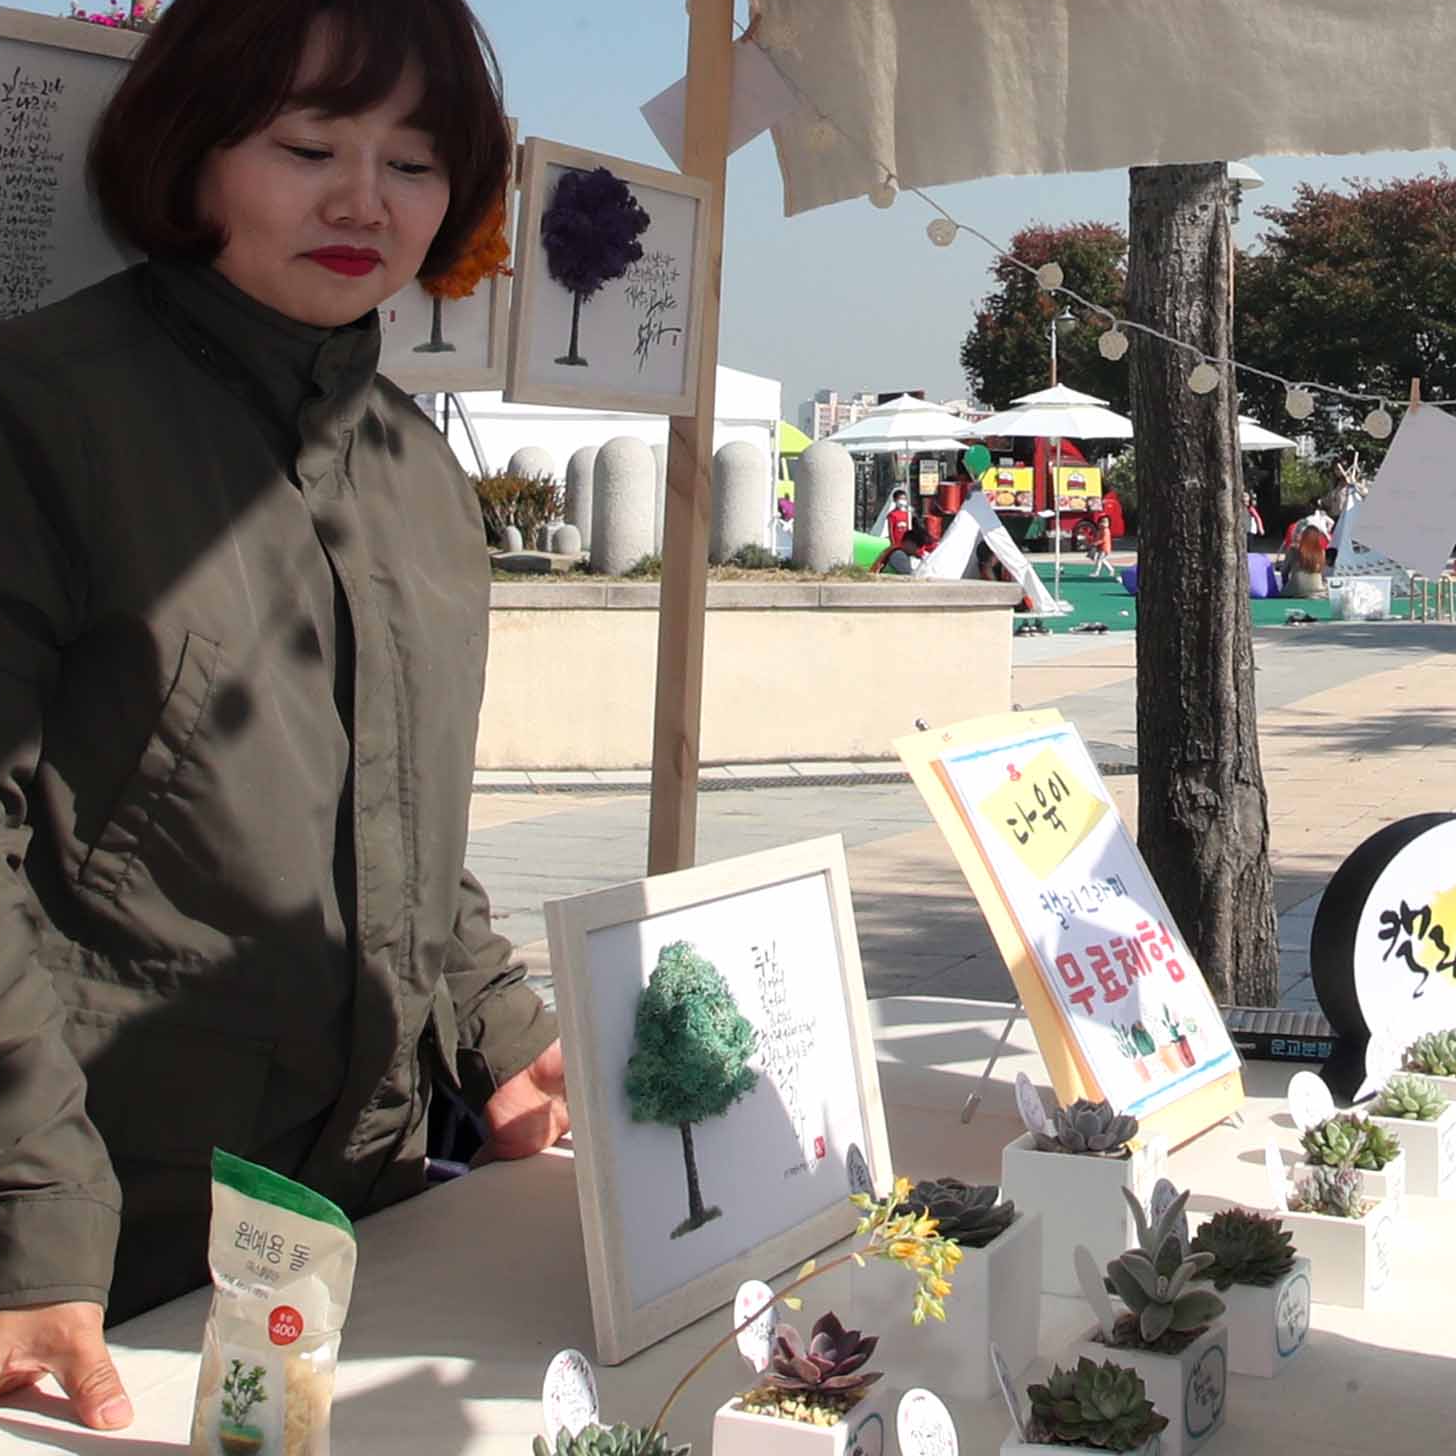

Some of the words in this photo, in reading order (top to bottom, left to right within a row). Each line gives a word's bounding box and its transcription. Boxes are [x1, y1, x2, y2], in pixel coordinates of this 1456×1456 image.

[1006, 770, 1070, 845] 다육이
[1055, 920, 1185, 1016] 무료체험
[234, 1221, 285, 1264] 원예용
